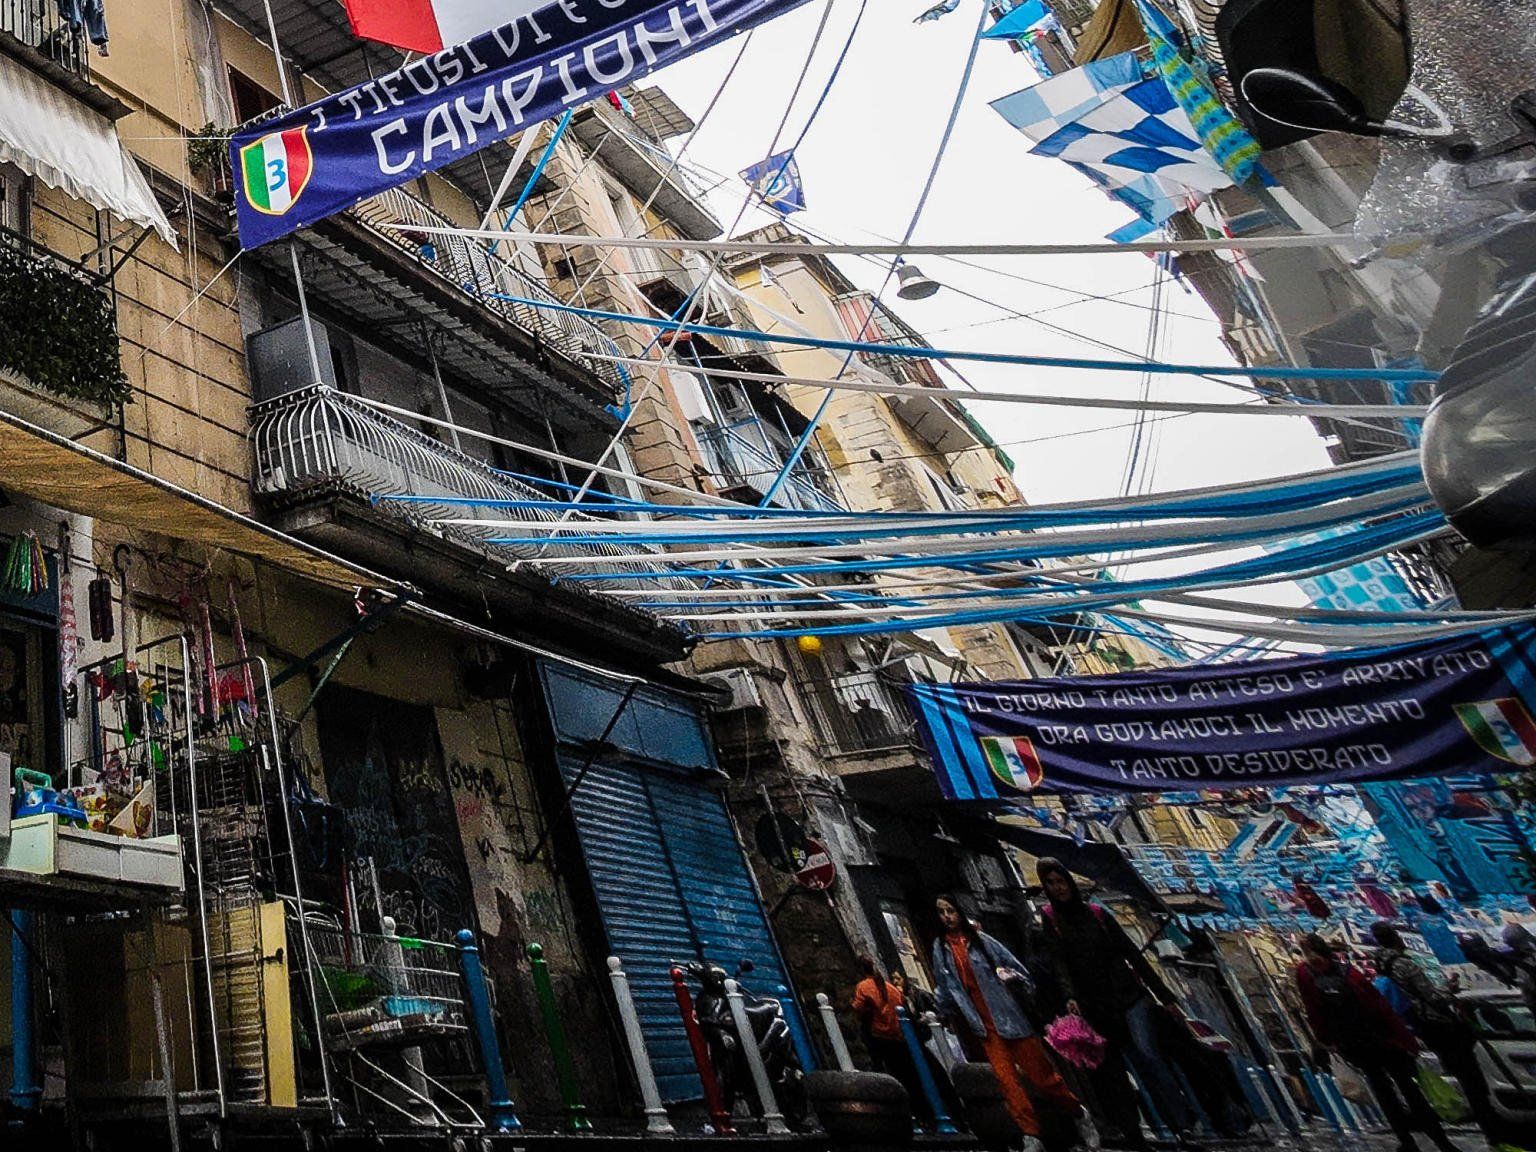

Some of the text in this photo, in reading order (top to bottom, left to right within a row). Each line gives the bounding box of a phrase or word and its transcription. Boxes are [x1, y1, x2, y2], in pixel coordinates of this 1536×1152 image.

[267, 158, 287, 191] 3
[963, 697, 991, 714] IL
[997, 690, 1086, 713] GIORNO
[1097, 685, 1177, 708] TANTO
[1189, 674, 1295, 701] ATTESO
[1342, 649, 1492, 687] ARRIVATO
[1036, 698, 1425, 746] ORA GODIAMOCI IL MOMENTO
[1110, 743, 1393, 780] TANTO DESIDERATO
